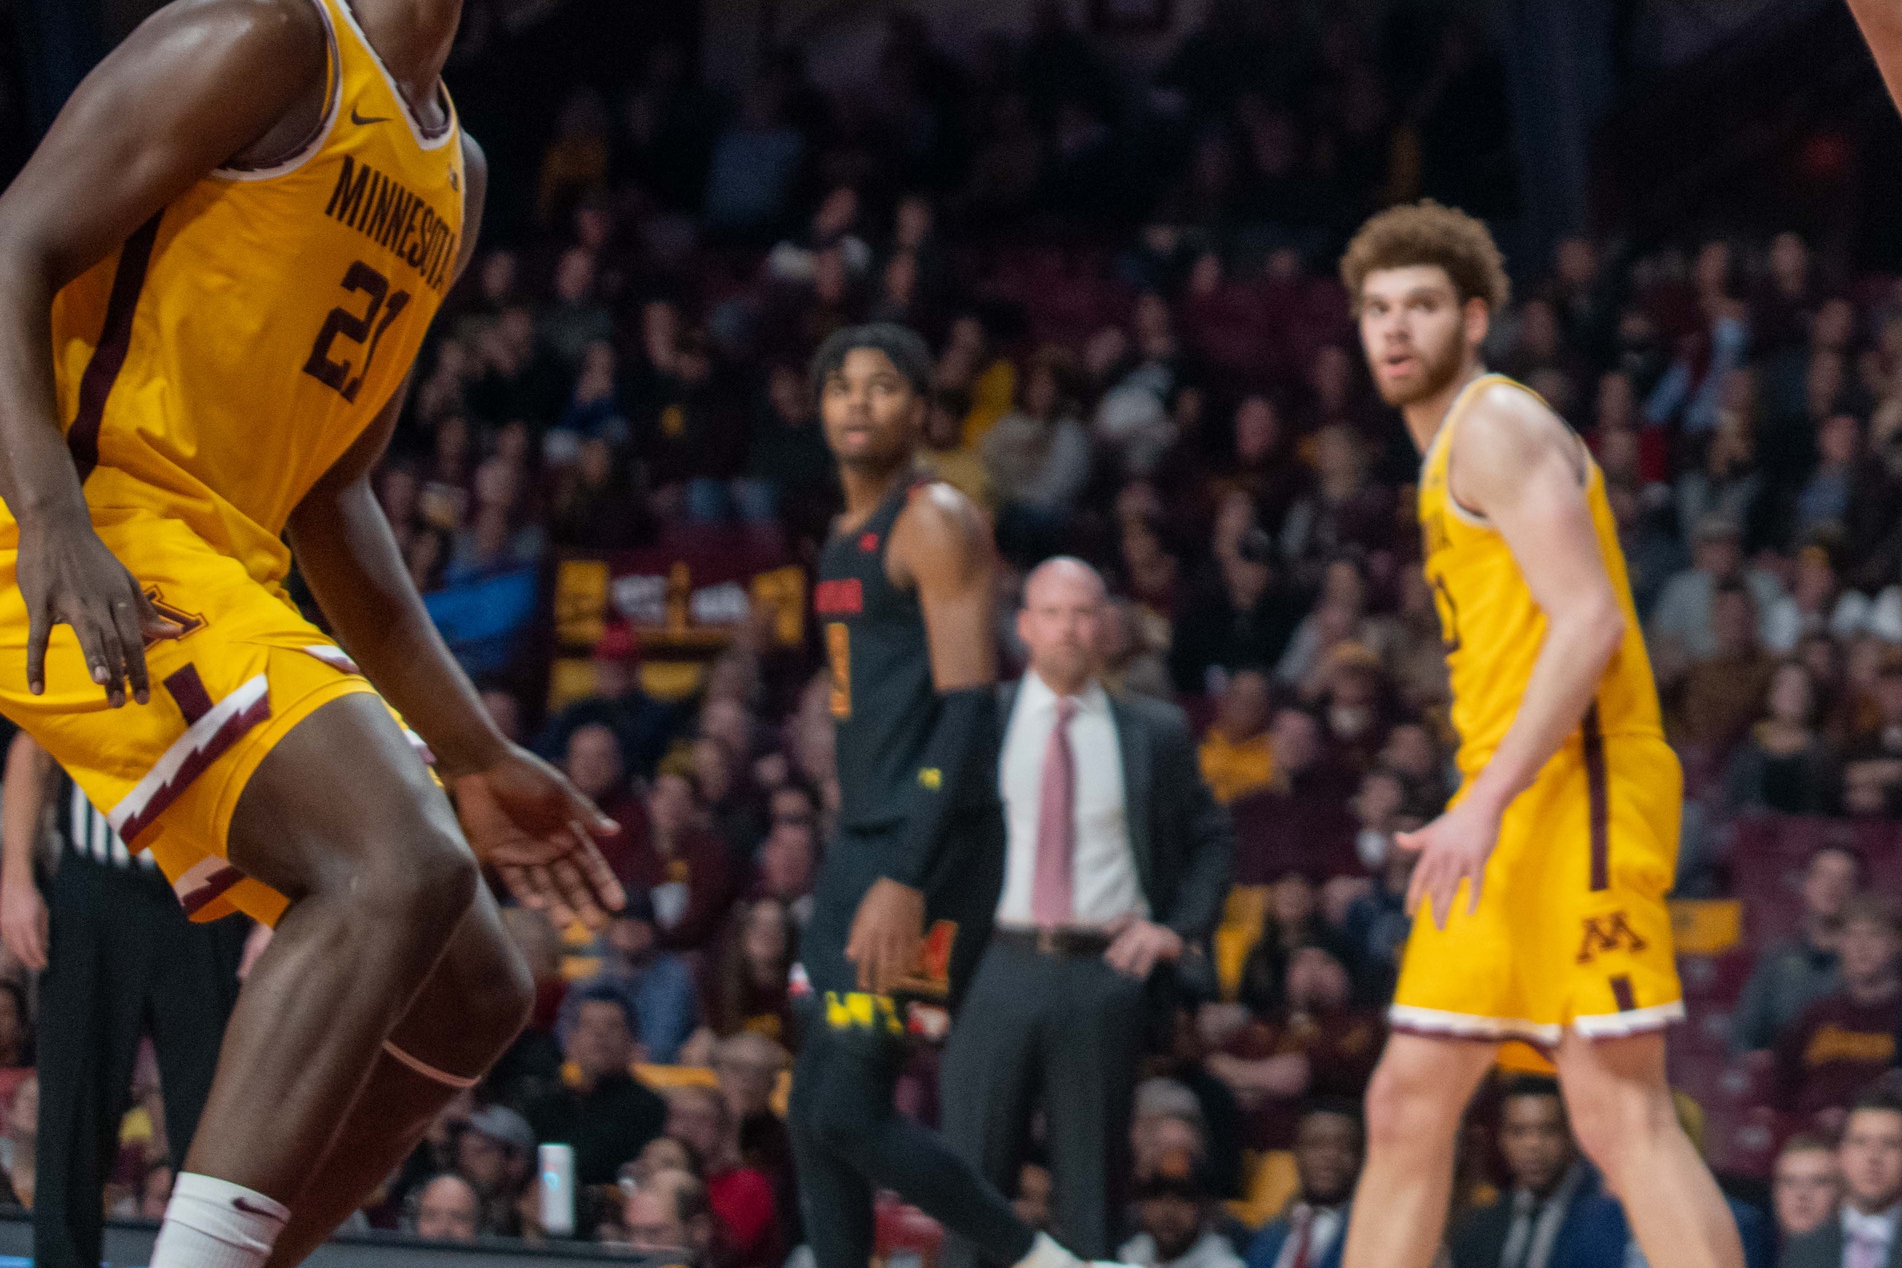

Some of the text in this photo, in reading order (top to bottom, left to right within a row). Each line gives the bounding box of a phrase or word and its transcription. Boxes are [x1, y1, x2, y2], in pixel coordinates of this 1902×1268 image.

[324, 153, 459, 299] MINNESOTA
[303, 258, 412, 406] 21
[1574, 909, 1648, 966] M
